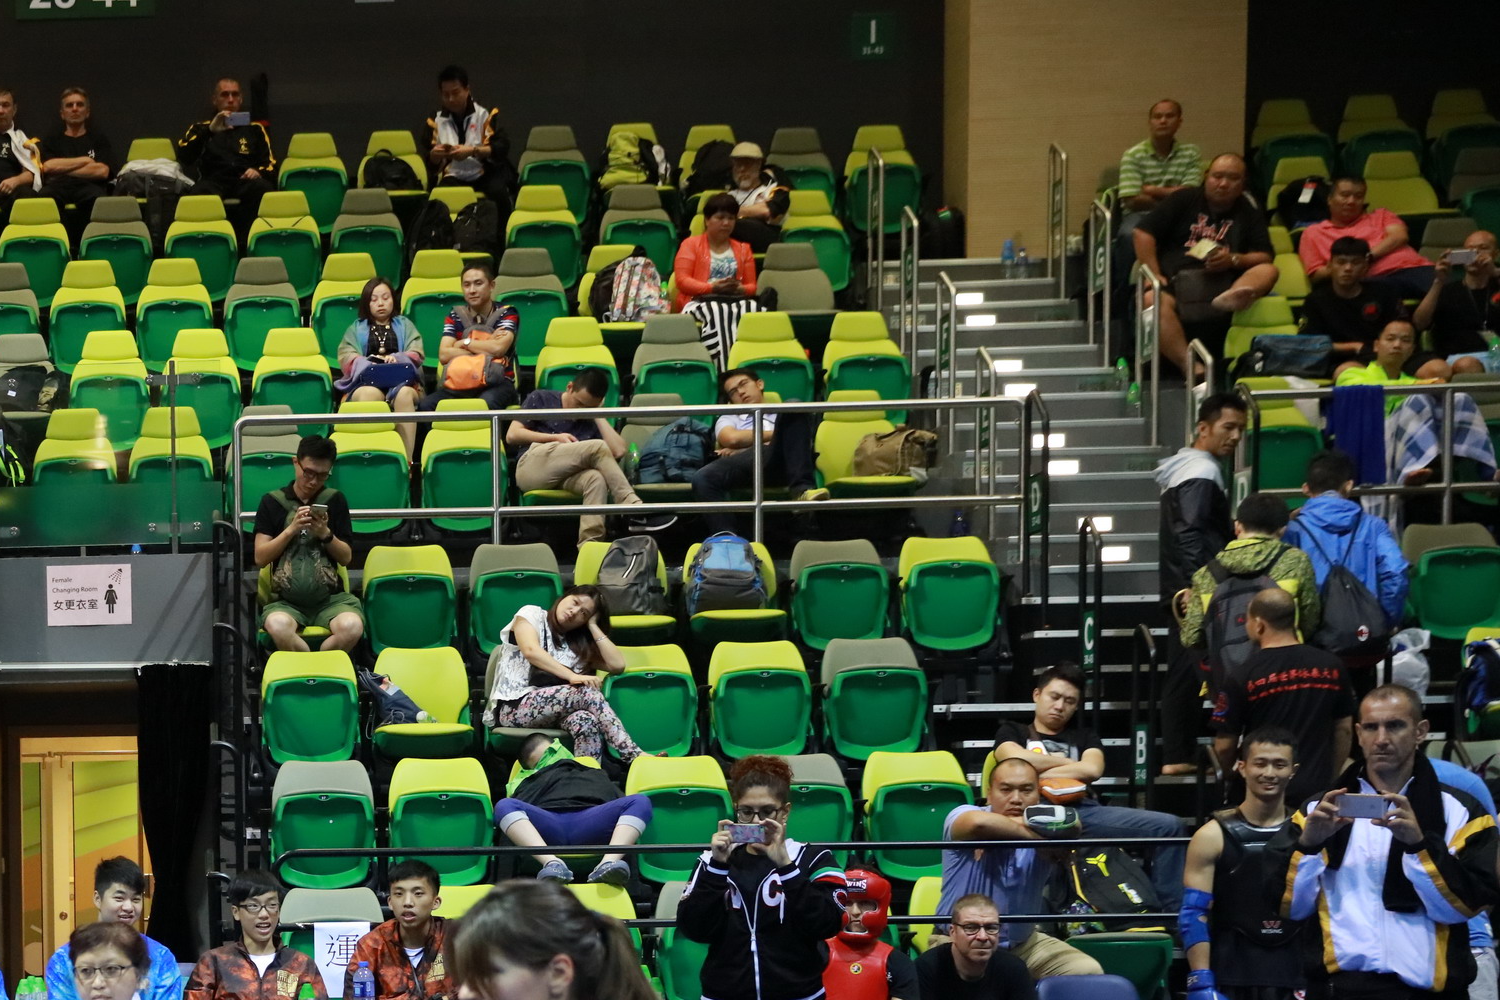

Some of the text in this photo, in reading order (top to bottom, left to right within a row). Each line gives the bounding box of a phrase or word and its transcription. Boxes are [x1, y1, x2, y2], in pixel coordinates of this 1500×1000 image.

[1096, 247, 1104, 275] G
[1031, 481, 1041, 514] D
[51, 586, 99, 596] Changing Room
[53, 599, 99, 611] 女更衣室
[1084, 617, 1095, 650] C
[1136, 731, 1148, 765] B
[326, 934, 359, 969] 運
